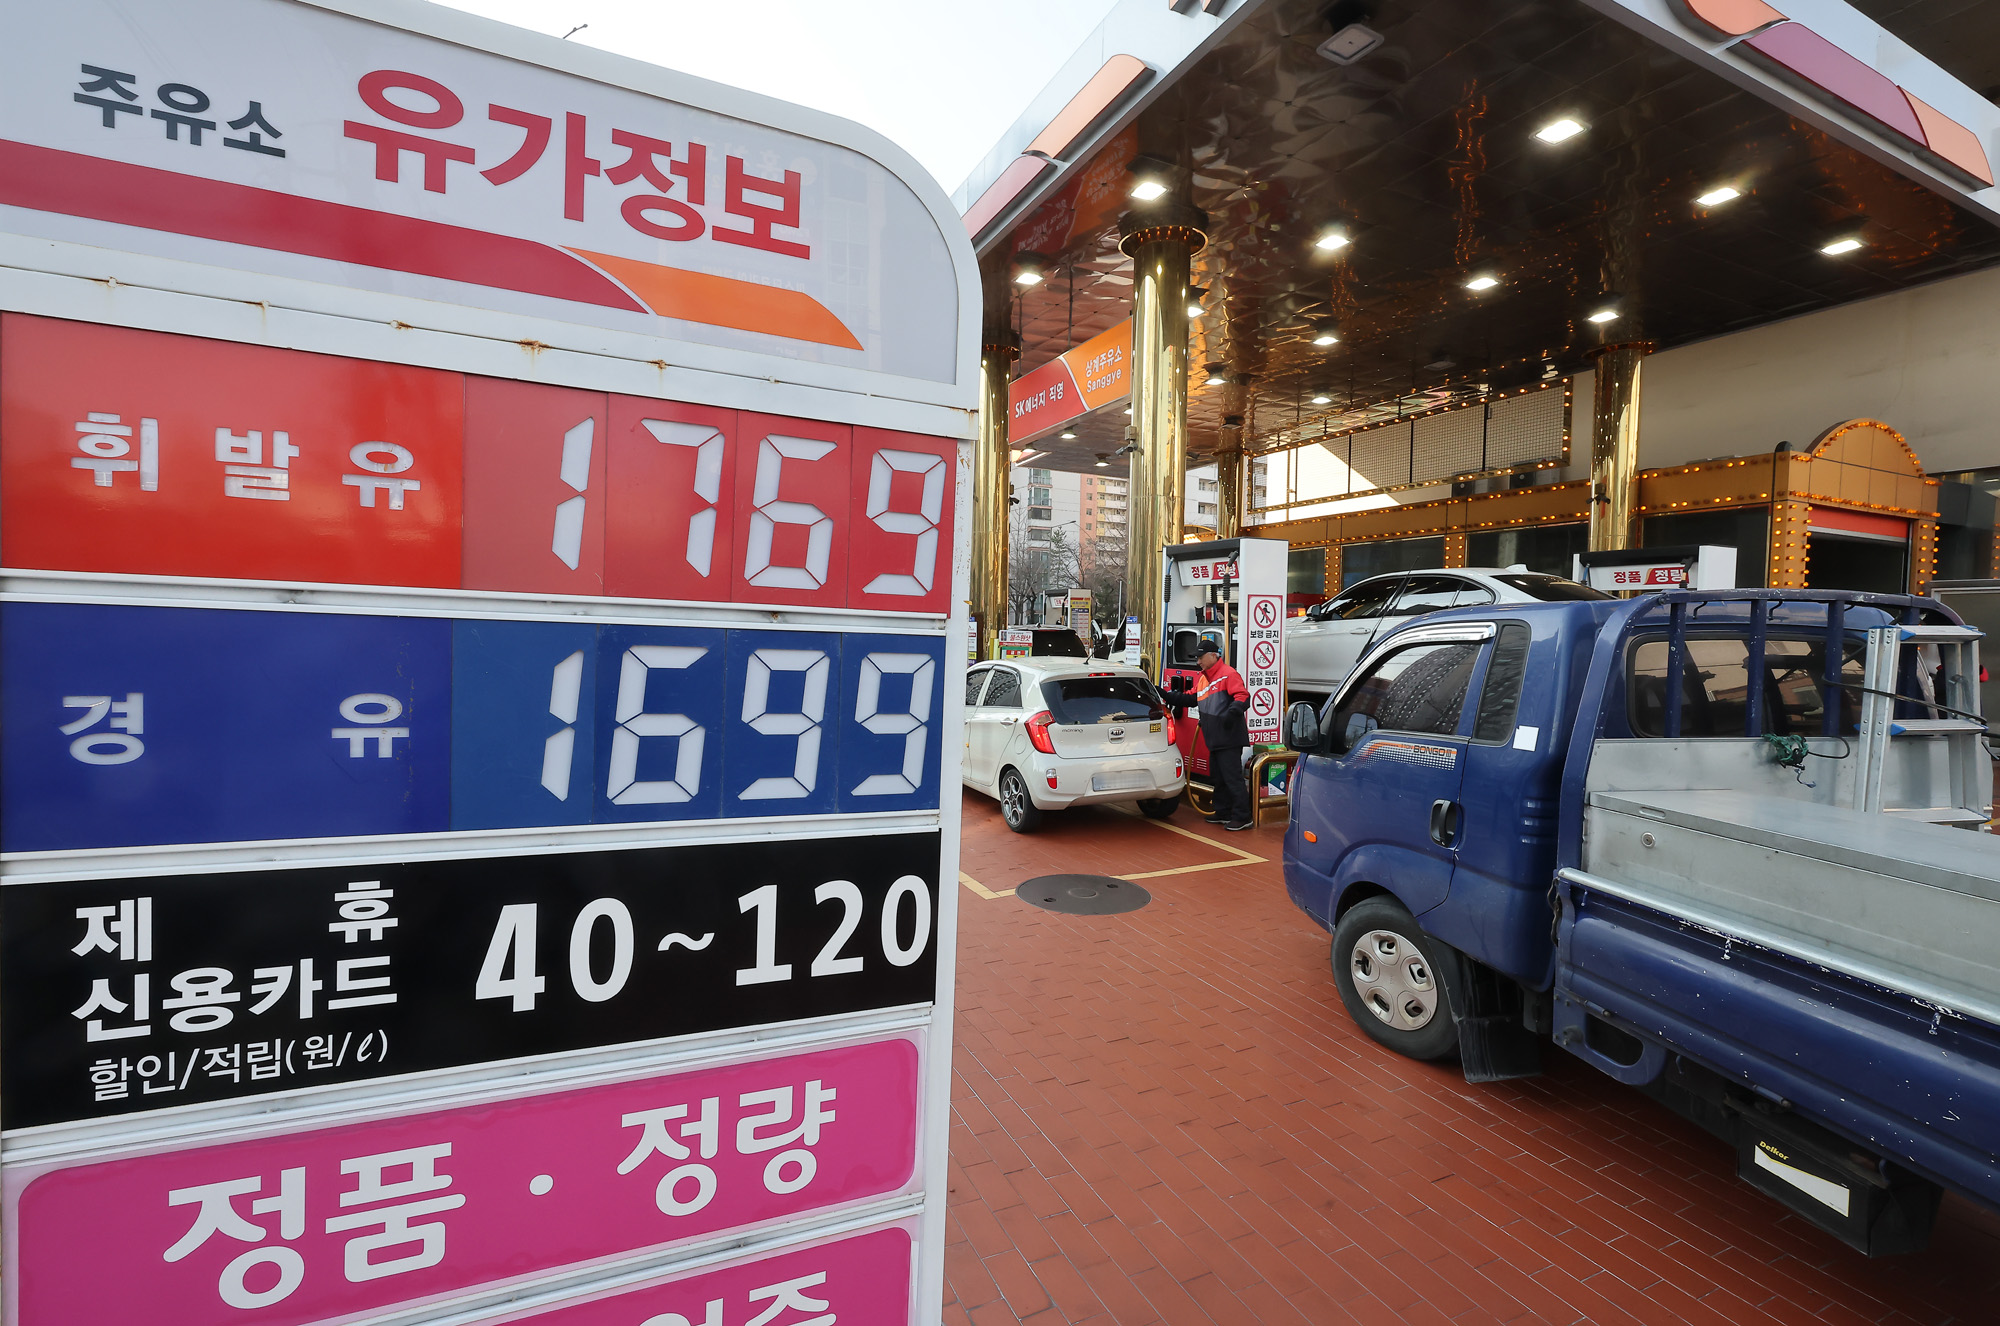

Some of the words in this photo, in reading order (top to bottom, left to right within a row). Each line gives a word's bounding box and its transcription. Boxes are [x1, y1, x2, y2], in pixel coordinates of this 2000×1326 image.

[73, 63, 286, 158] 주유소
[344, 69, 811, 260] 유가정보
[1085, 345, 1122, 378] 상계주유소
[1087, 369, 1122, 393] Sanggye
[1015, 390, 1046, 418] SK에너지
[1049, 381, 1064, 402] 직영
[551, 416, 947, 597] 1769
[1191, 565, 1209, 579] 정품
[1613, 571, 1641, 584] 정품
[1250, 630, 1264, 639] 보행
[1266, 630, 1279, 639] 금지
[1265, 677, 1278, 685] 금지
[541, 645, 936, 806] 1699
[1264, 718, 1277, 726] 금지
[71, 955, 398, 1043] 신용카드
[1759, 1140, 1790, 1160] Delkor
[163, 1141, 467, 1309] 정품
[616, 1079, 837, 1217] 정량
